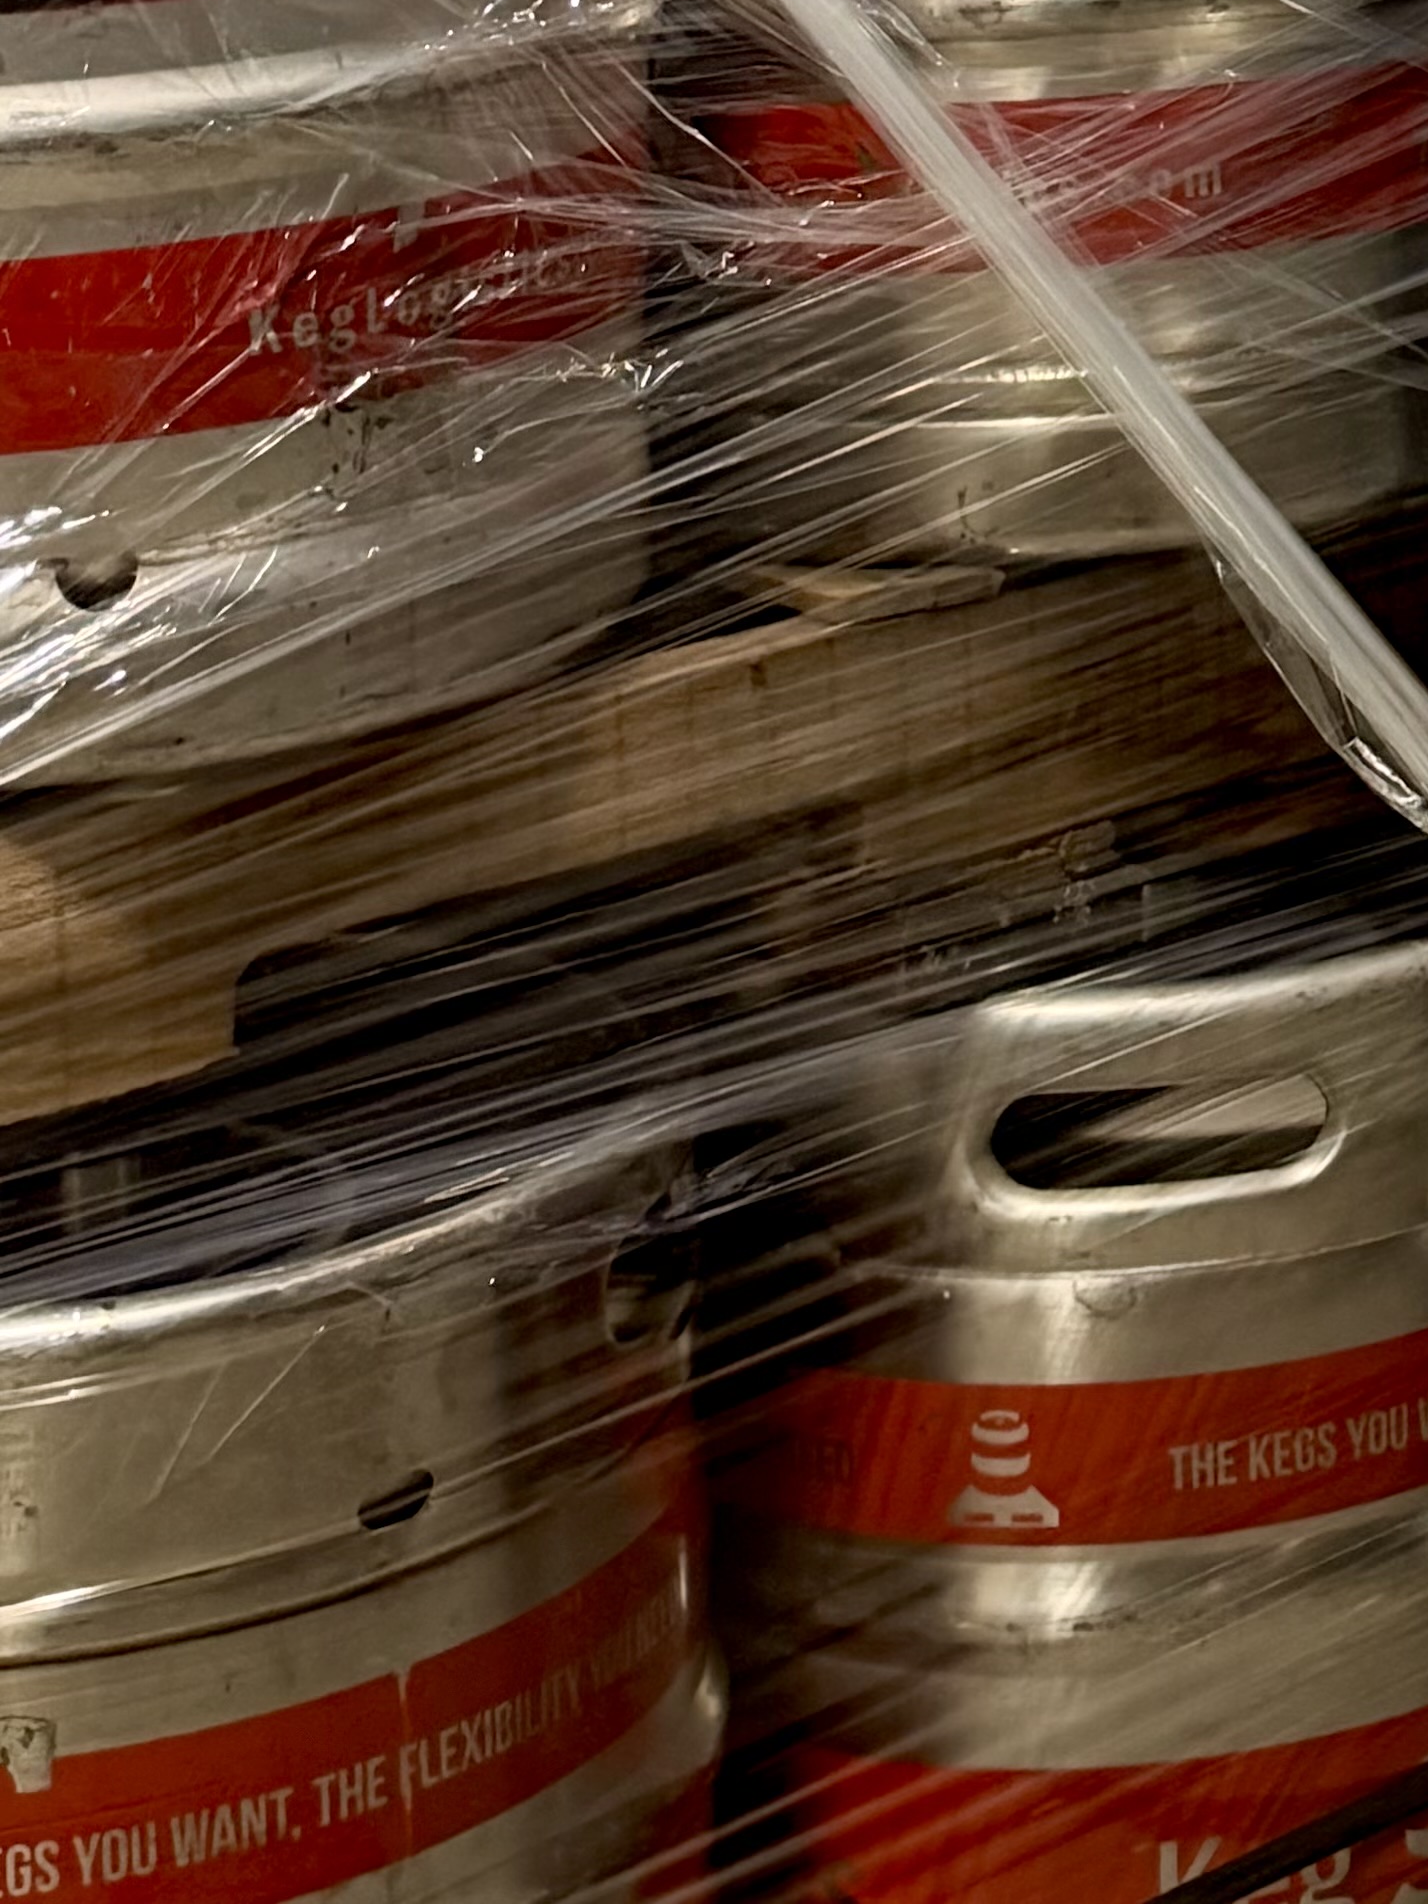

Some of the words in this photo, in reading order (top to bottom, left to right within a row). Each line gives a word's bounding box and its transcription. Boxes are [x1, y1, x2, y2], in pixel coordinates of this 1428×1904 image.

[1167, 1442, 1238, 1491] THE
[1246, 1421, 1337, 1484] KEGS
[1346, 1403, 1410, 1457] YOU
[72, 1816, 158, 1884] YOU
[169, 1788, 302, 1869] WANT,
[310, 1753, 389, 1827] THE
